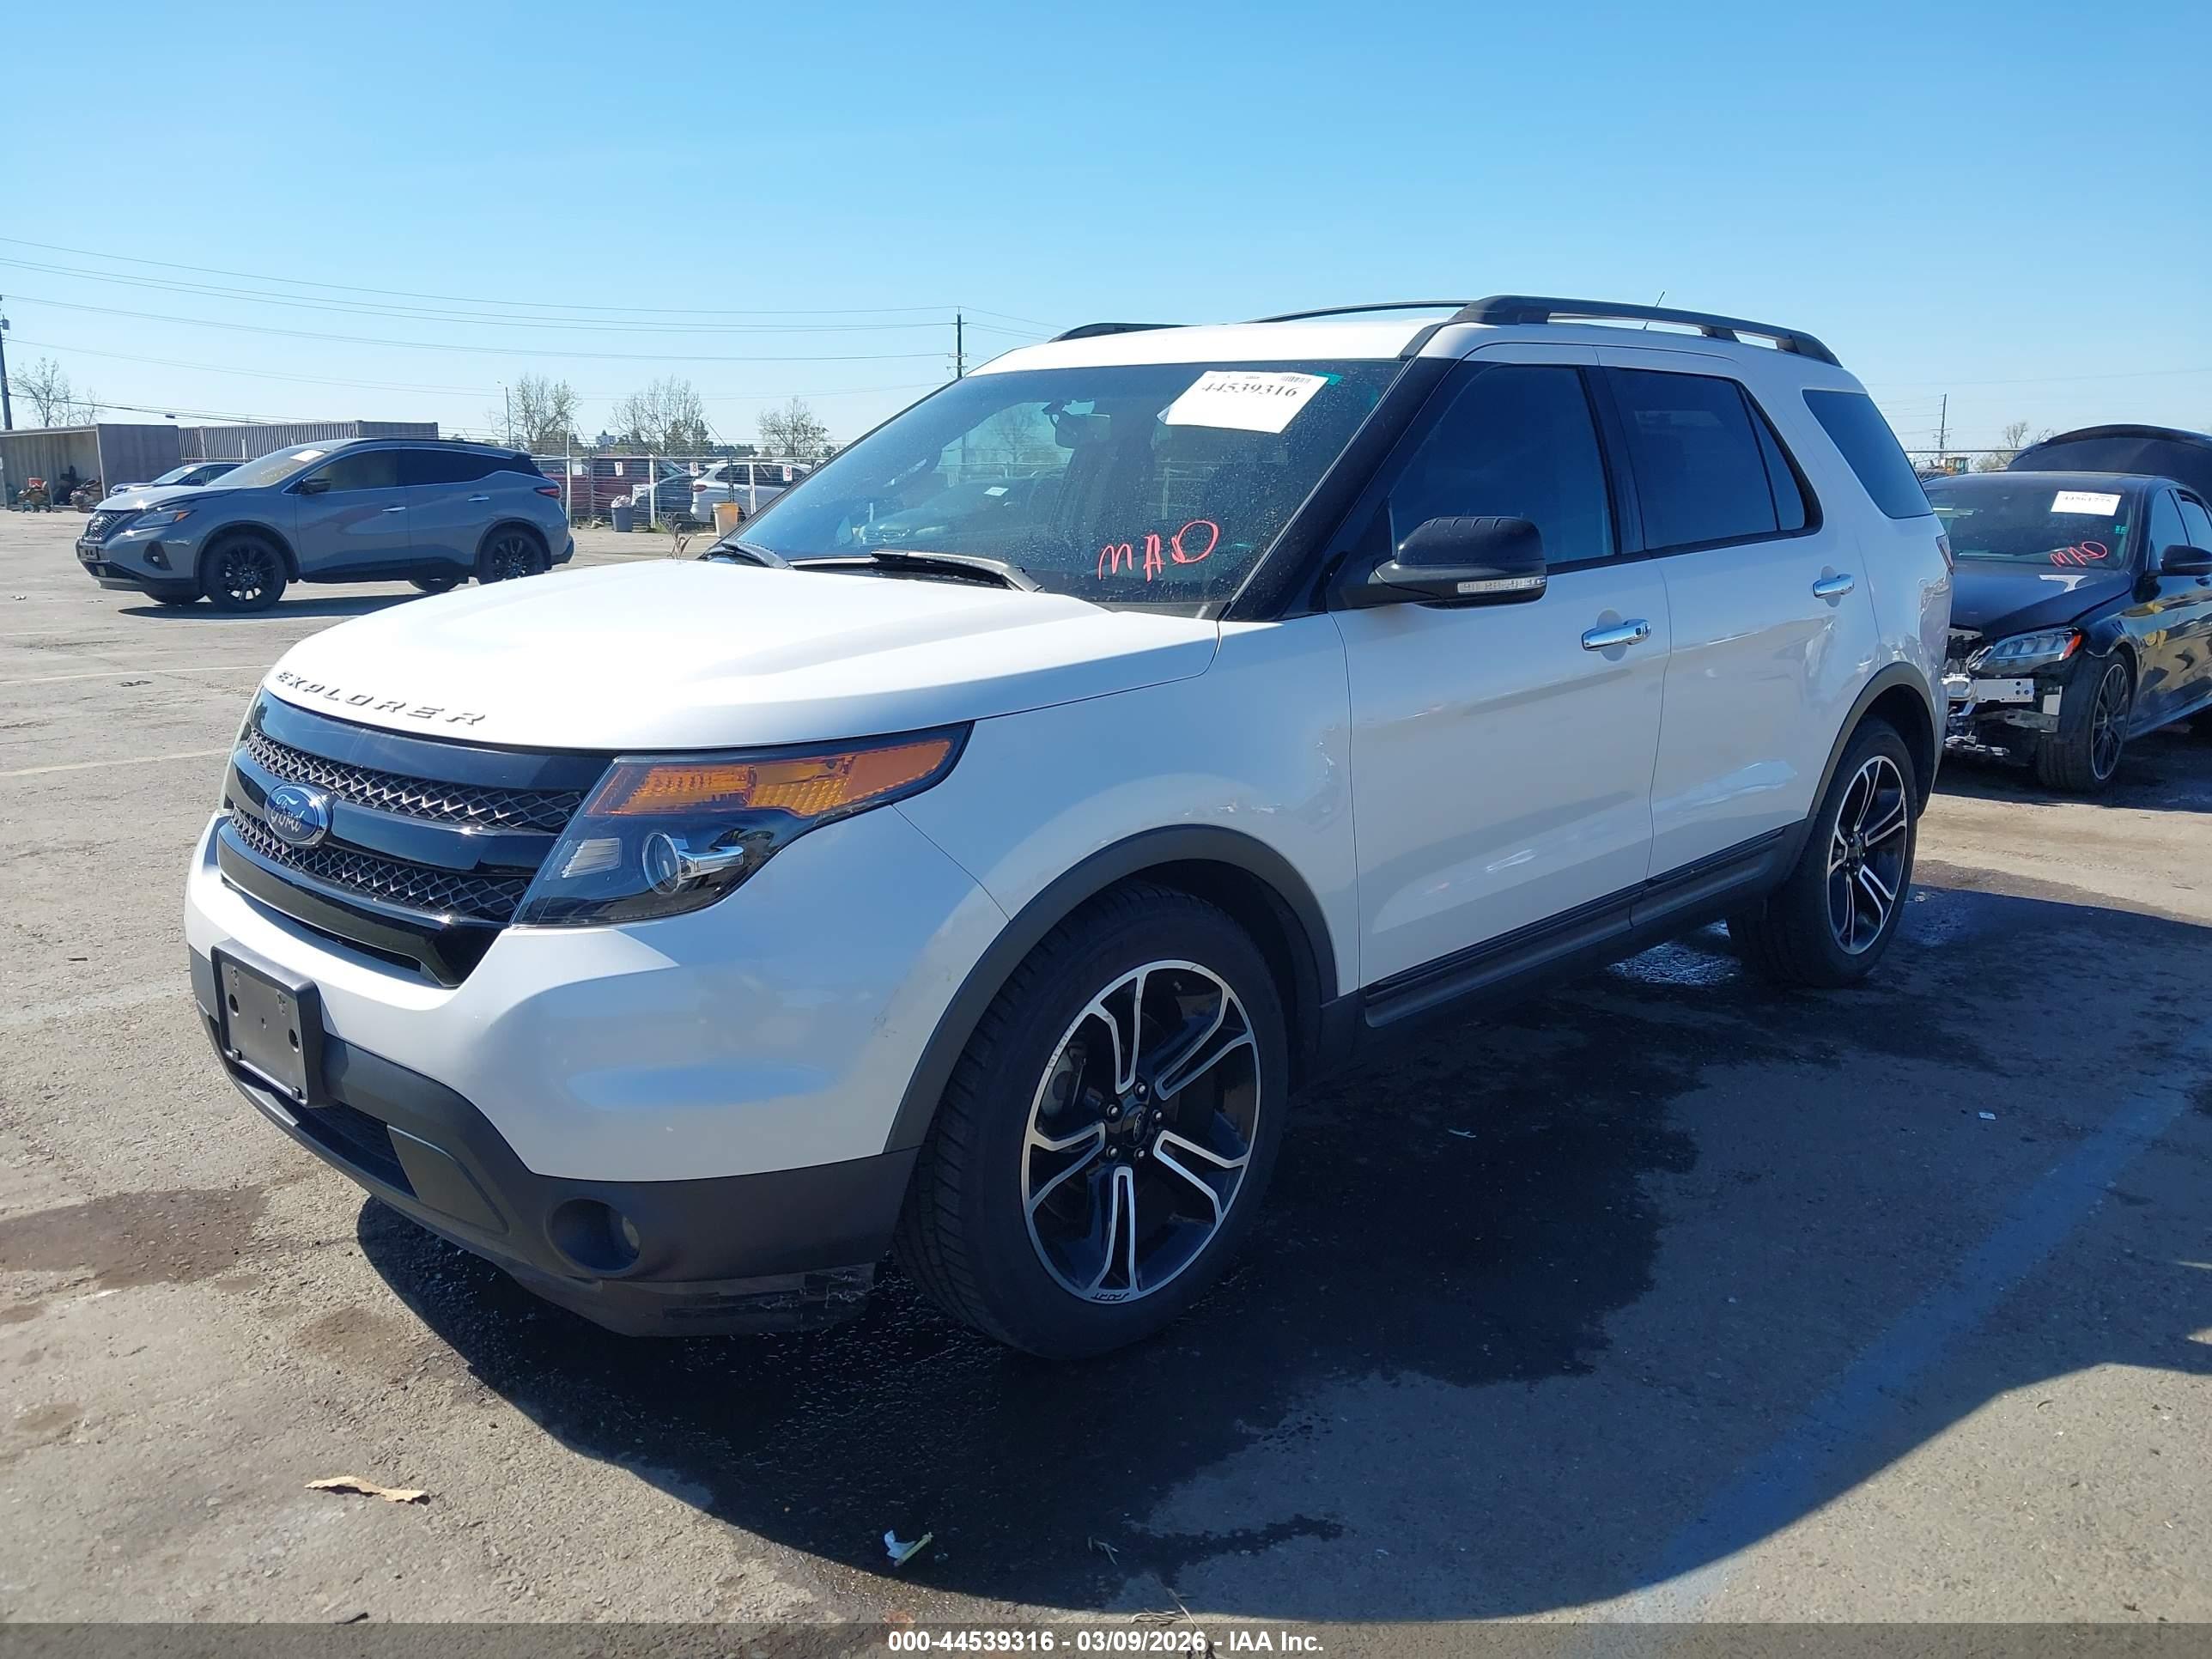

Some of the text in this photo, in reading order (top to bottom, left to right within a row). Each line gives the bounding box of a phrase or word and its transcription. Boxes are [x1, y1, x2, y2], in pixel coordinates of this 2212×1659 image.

[1201, 382, 1300, 398] 44539316
[275, 670, 486, 726] EXPLORER
[270, 793, 307, 833] Ford
